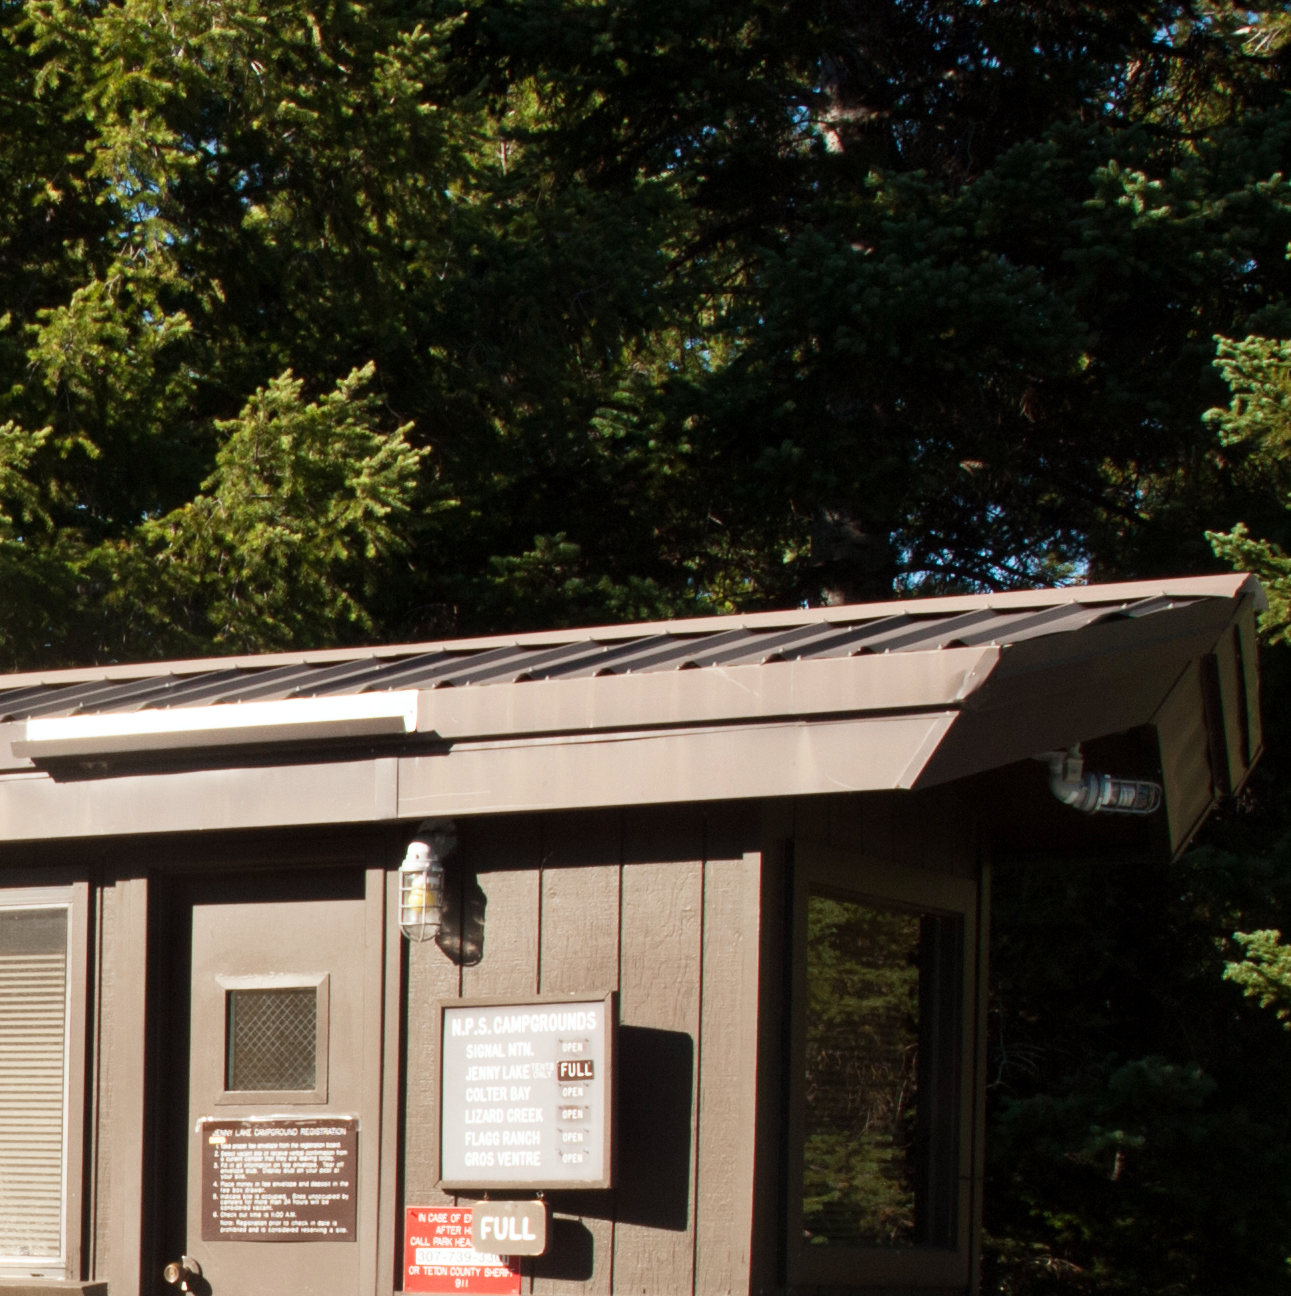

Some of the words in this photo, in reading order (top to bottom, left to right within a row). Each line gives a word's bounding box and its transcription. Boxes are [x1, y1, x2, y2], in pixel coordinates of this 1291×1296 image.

[452, 1018, 491, 1037] N.P.S.
[493, 1011, 597, 1034] CAMPGROUNDS
[465, 1043, 505, 1059] SIGNAL
[507, 1042, 535, 1057] MTN.
[562, 1042, 583, 1053] OPEN
[465, 1065, 501, 1081] JENNY
[502, 1064, 531, 1080] LAKE
[560, 1062, 593, 1077] FULL
[465, 1087, 507, 1102] COLTER
[510, 1086, 531, 1101] BAY
[562, 1087, 583, 1097] OPEN
[465, 1109, 504, 1124] LIZARD
[507, 1108, 543, 1122] CREEK
[562, 1109, 583, 1120] OPEN
[212, 1129, 233, 1137] JENNY
[235, 1128, 252, 1137] LAKE
[254, 1128, 298, 1137] CAMPGROUND
[300, 1127, 347, 1136] REGISTRATION
[465, 1131, 500, 1146] FLAGG
[502, 1130, 540, 1145] RANCH
[562, 1132, 583, 1142] OPEN
[465, 1152, 494, 1166] GROS
[497, 1151, 541, 1166] VENTRE
[562, 1153, 583, 1164] OPEN
[418, 1213, 426, 1223] IN
[428, 1213, 448, 1223] CASE
[450, 1213, 461, 1223] OF
[436, 1226, 461, 1235] AFTER
[480, 1216, 536, 1240] FULL
[410, 1236, 431, 1246] CALL
[433, 1236, 453, 1246] PARK
[408, 1266, 420, 1276] OR
[423, 1266, 448, 1276] TETON
[450, 1266, 481, 1277] COUNTY
[454, 1278, 469, 1288] 911
